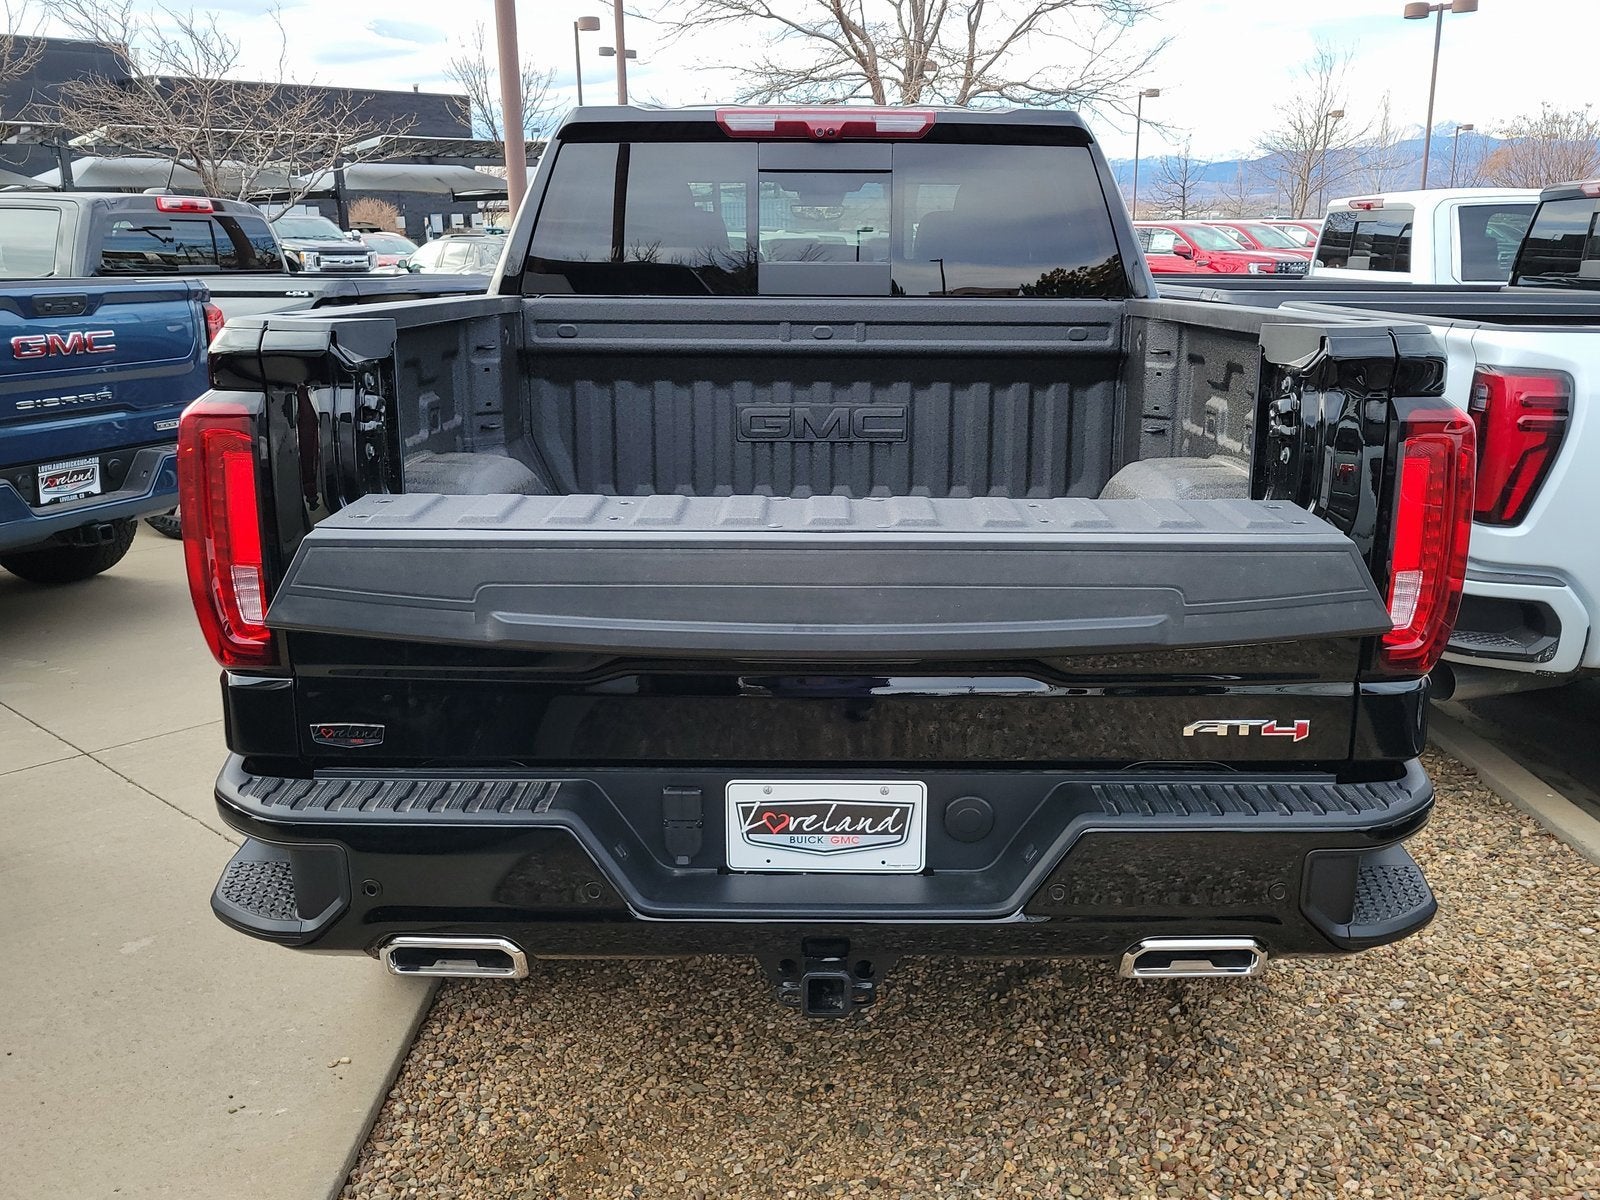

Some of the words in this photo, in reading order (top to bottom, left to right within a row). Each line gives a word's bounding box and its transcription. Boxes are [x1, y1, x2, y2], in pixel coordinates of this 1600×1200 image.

[11, 330, 116, 359] GMC
[16, 391, 112, 410] SIERRA
[741, 407, 904, 438] GMC
[1183, 719, 1311, 742] AT4
[742, 801, 903, 834] Loveland
[789, 835, 824, 844] BUICK
[830, 835, 860, 844] GMC
